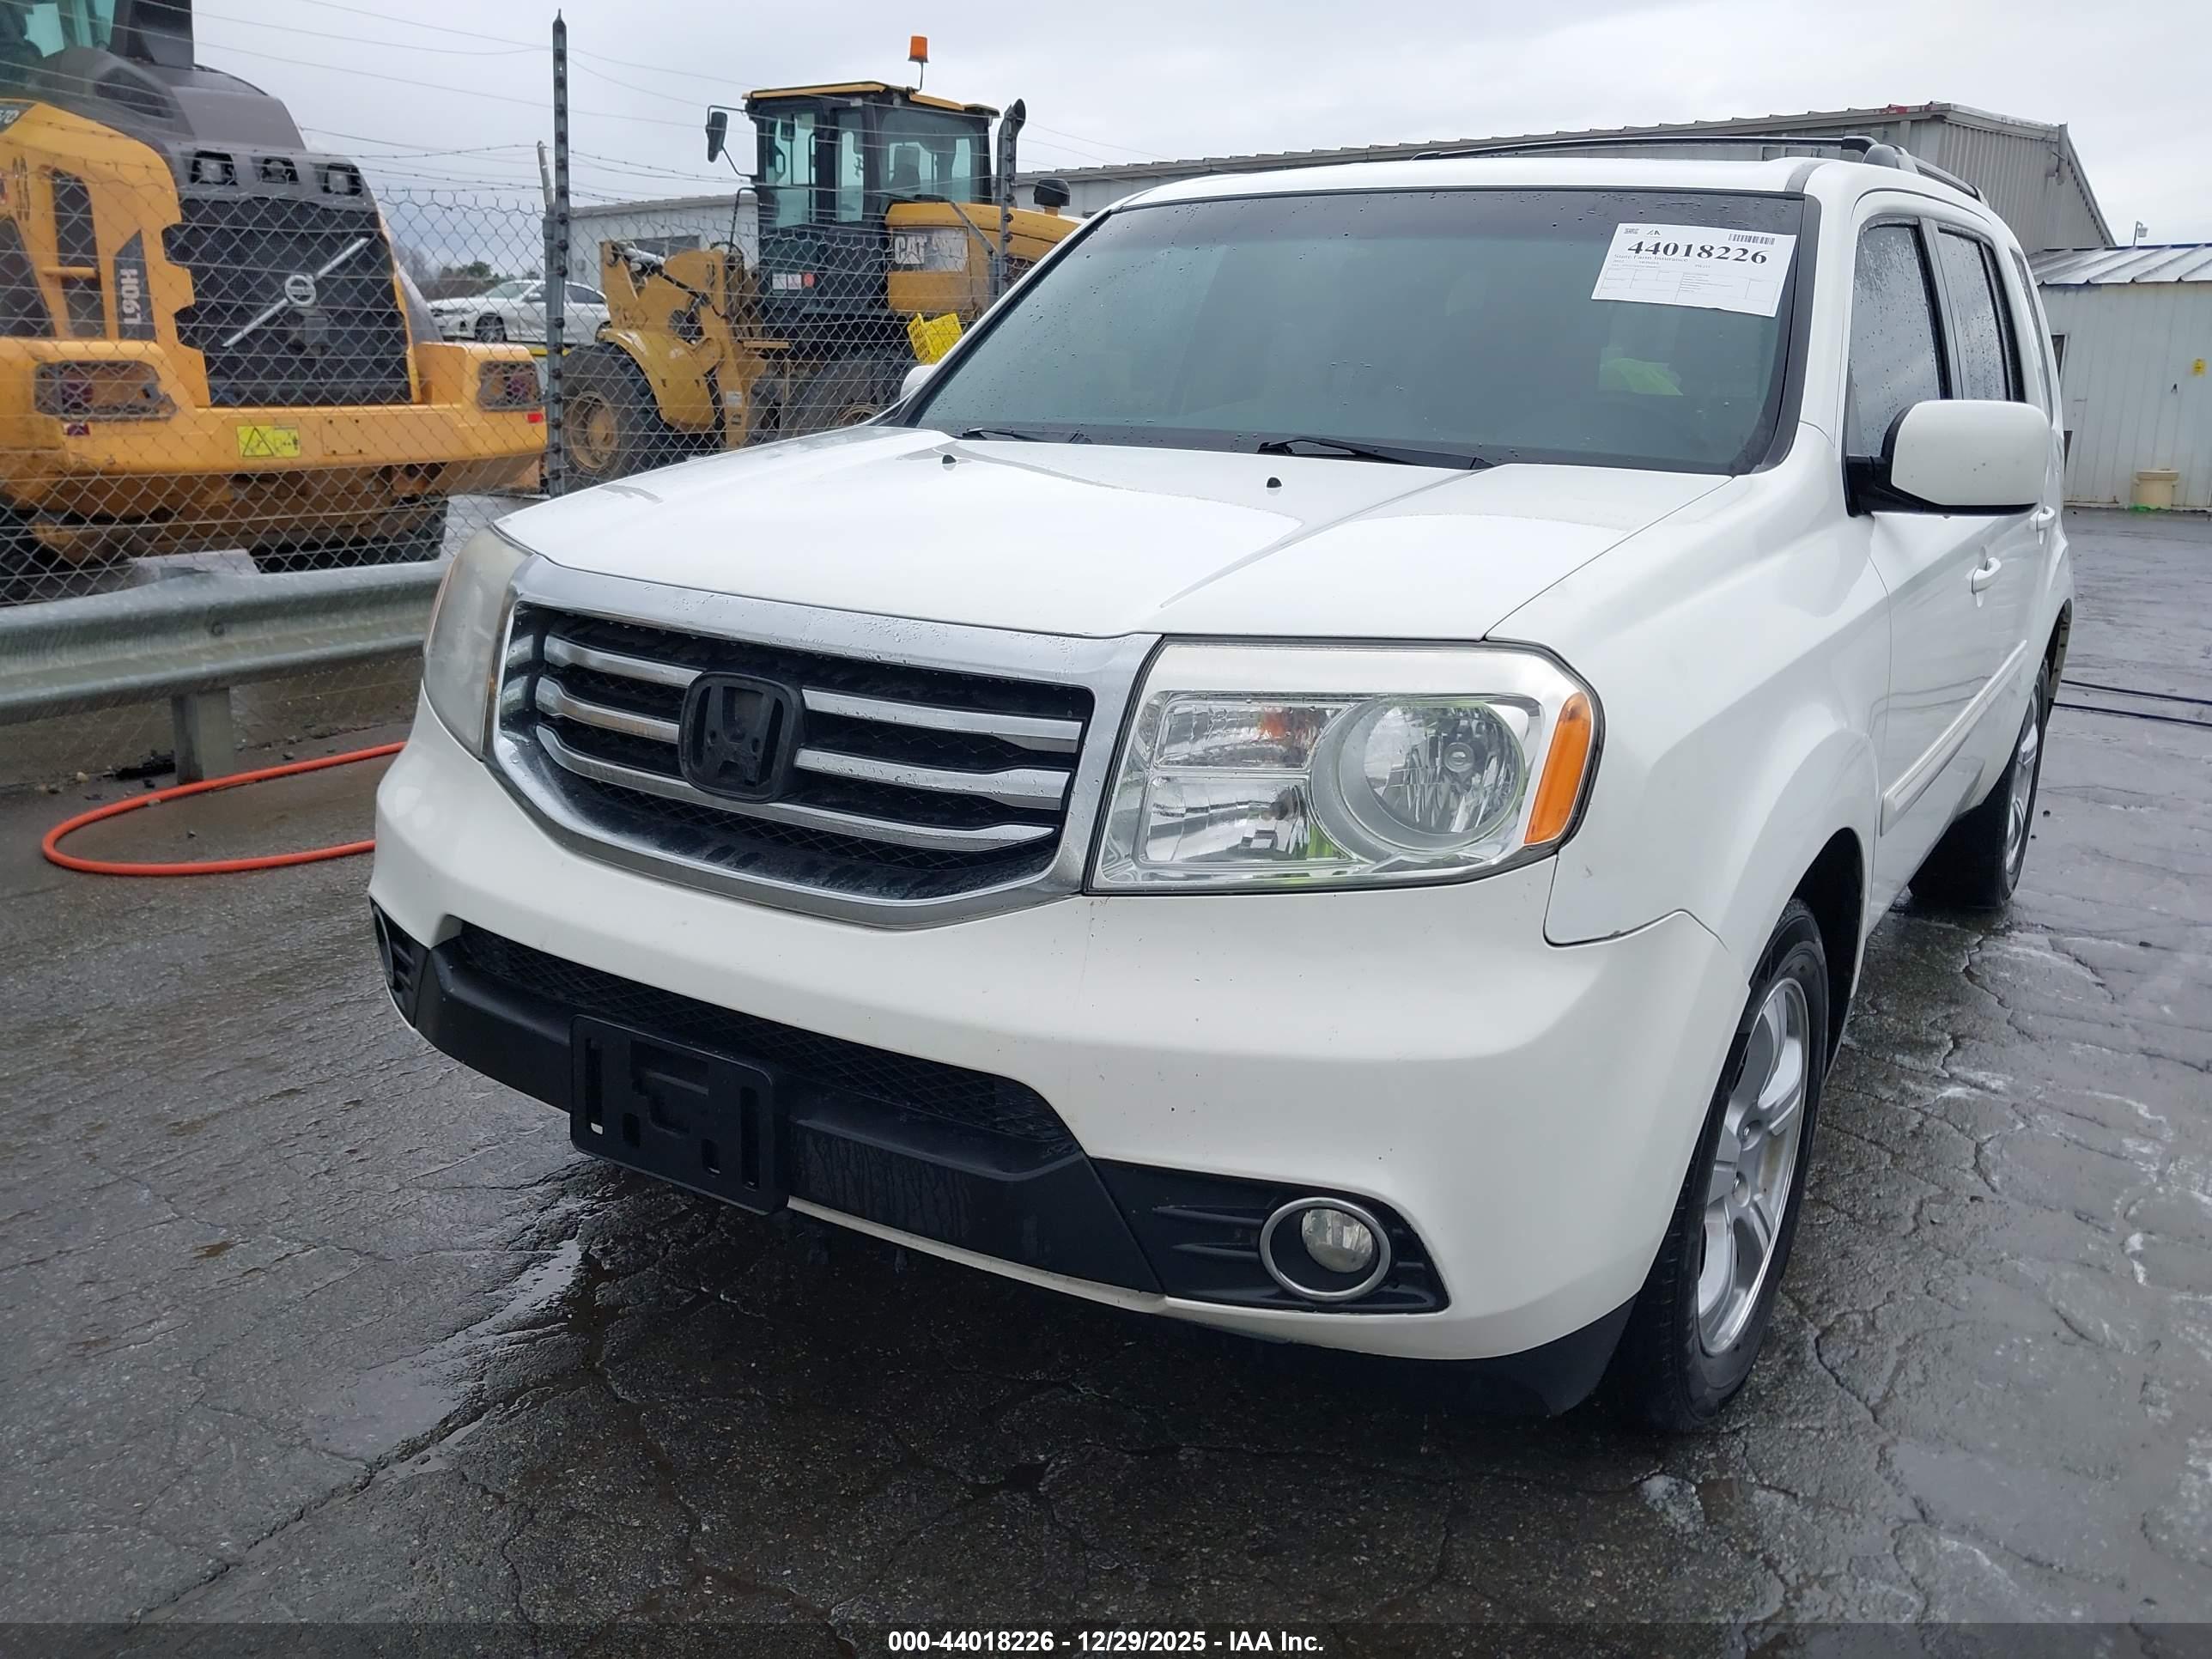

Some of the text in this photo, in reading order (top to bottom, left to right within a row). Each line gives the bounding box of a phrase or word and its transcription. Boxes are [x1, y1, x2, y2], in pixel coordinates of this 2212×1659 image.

[895, 236, 927, 264] CAT
[1627, 240, 1771, 264] 44018226
[120, 269, 142, 325] L90H
